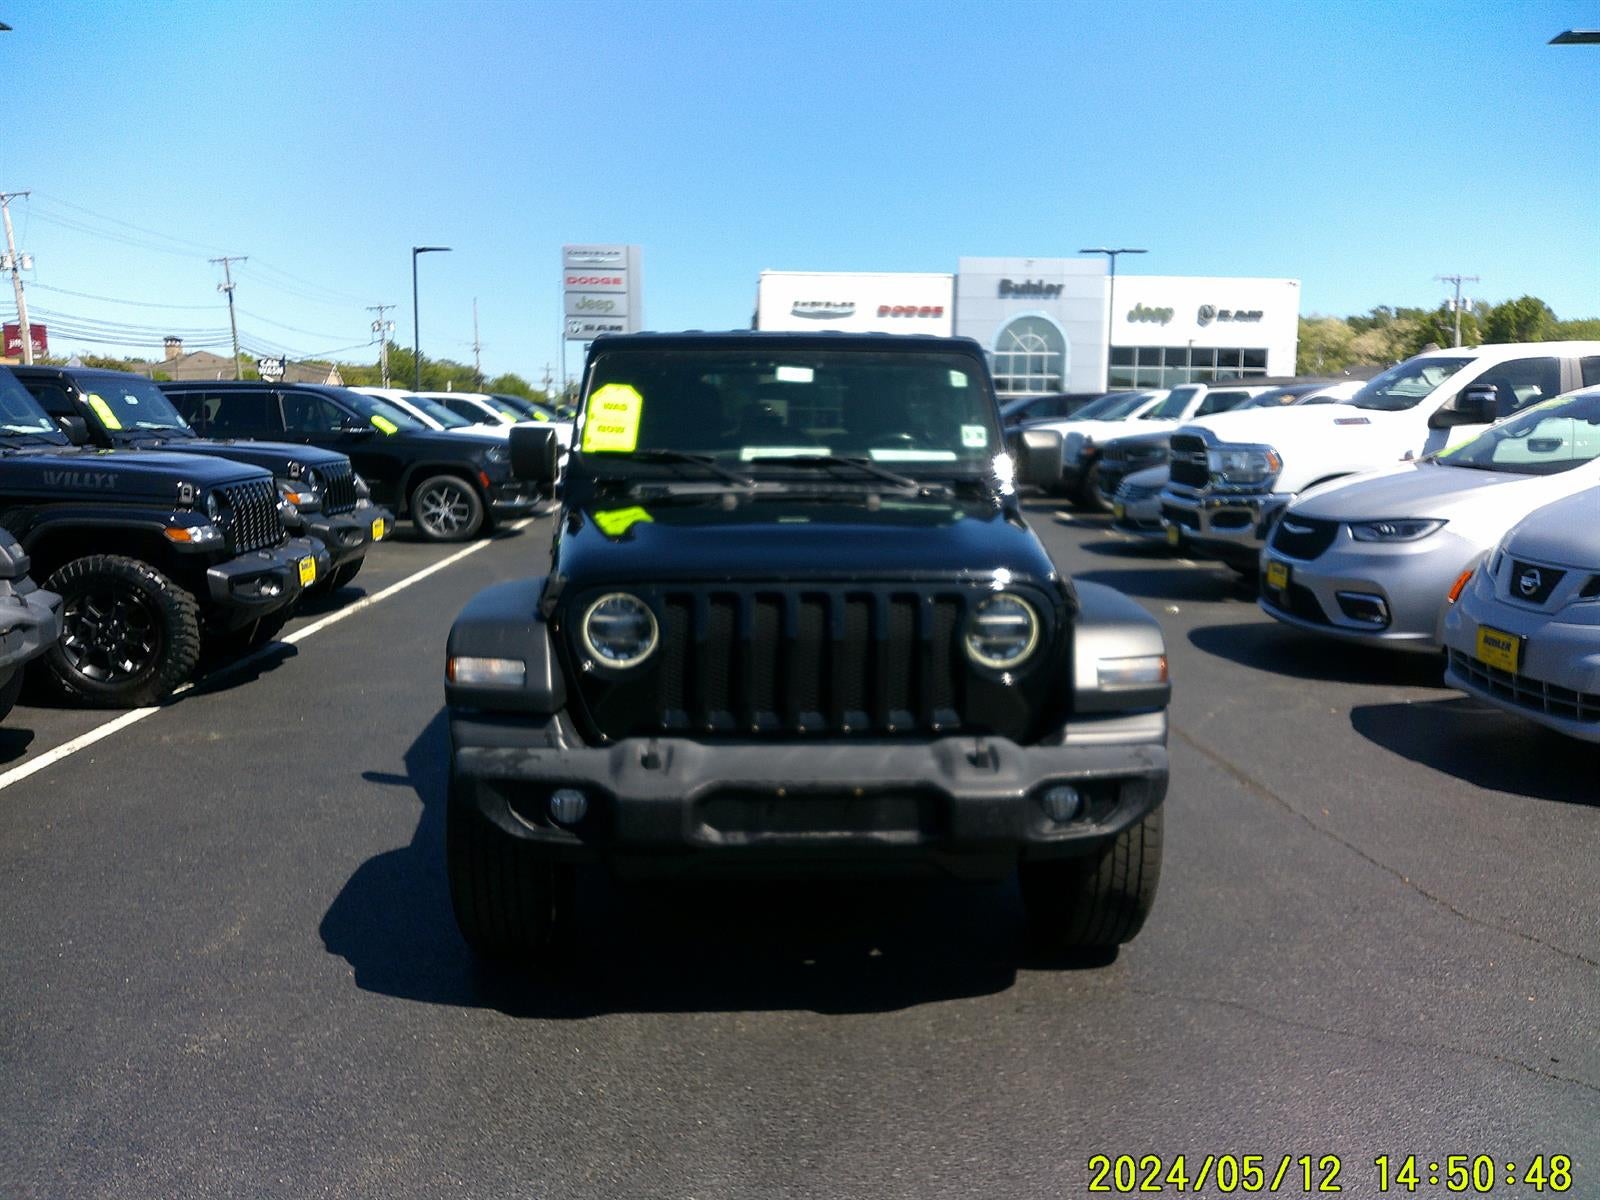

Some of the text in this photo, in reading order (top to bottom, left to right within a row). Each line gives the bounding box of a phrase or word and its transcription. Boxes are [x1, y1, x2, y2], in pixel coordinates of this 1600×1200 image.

[566, 276, 623, 285] DODGE
[999, 278, 1064, 299] Buhler
[575, 295, 615, 312] Jeep
[877, 304, 944, 318] DODGE
[1127, 302, 1174, 326] Jeep
[597, 424, 625, 434] NOW
[43, 470, 119, 489] WILLYS
